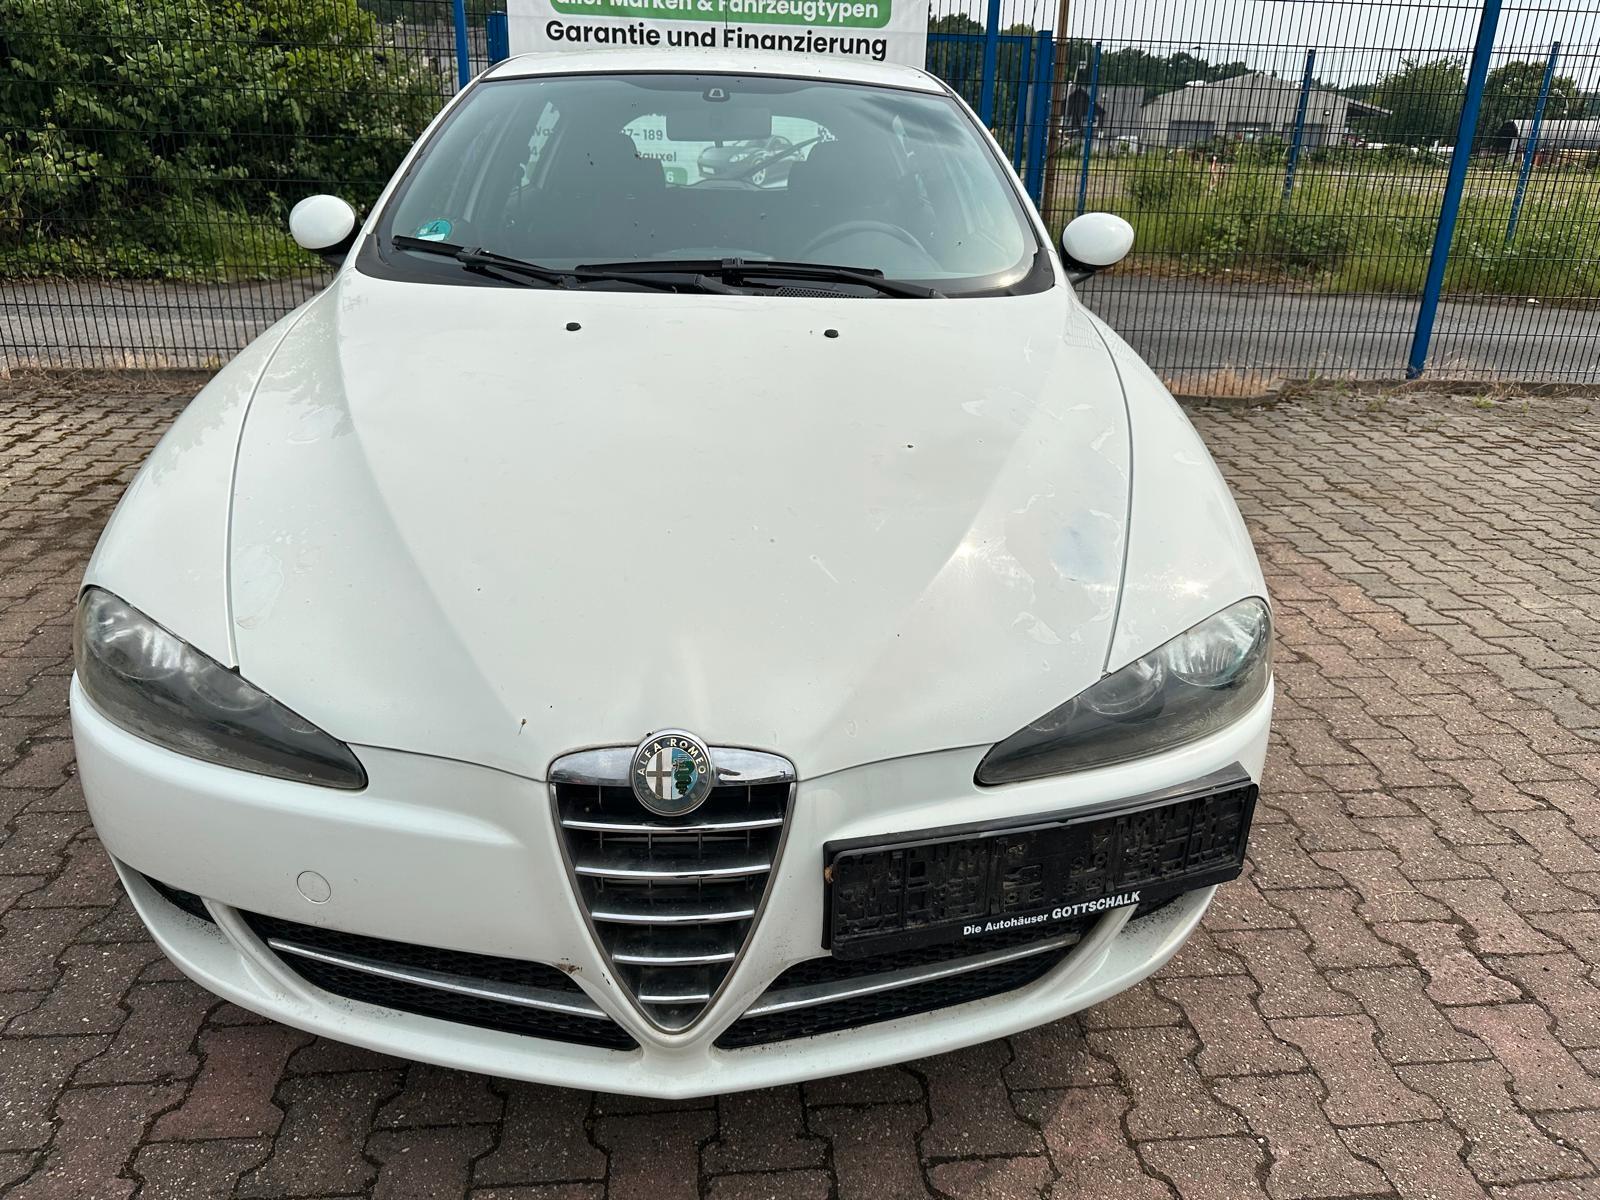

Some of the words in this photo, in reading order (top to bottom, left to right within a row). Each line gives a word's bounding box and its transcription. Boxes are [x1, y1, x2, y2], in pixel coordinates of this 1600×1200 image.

[718, 0, 878, 22] Fahrzeugtypen
[546, 20, 661, 46] Garantie
[667, 27, 716, 47] und
[723, 27, 887, 61] Finanzierung
[637, 742, 662, 776] ALFA
[670, 738, 706, 774] ROMEO
[963, 924, 982, 935] Die
[984, 913, 1049, 931] Autohäuser
[1052, 890, 1141, 919] GOTTSCHALK
